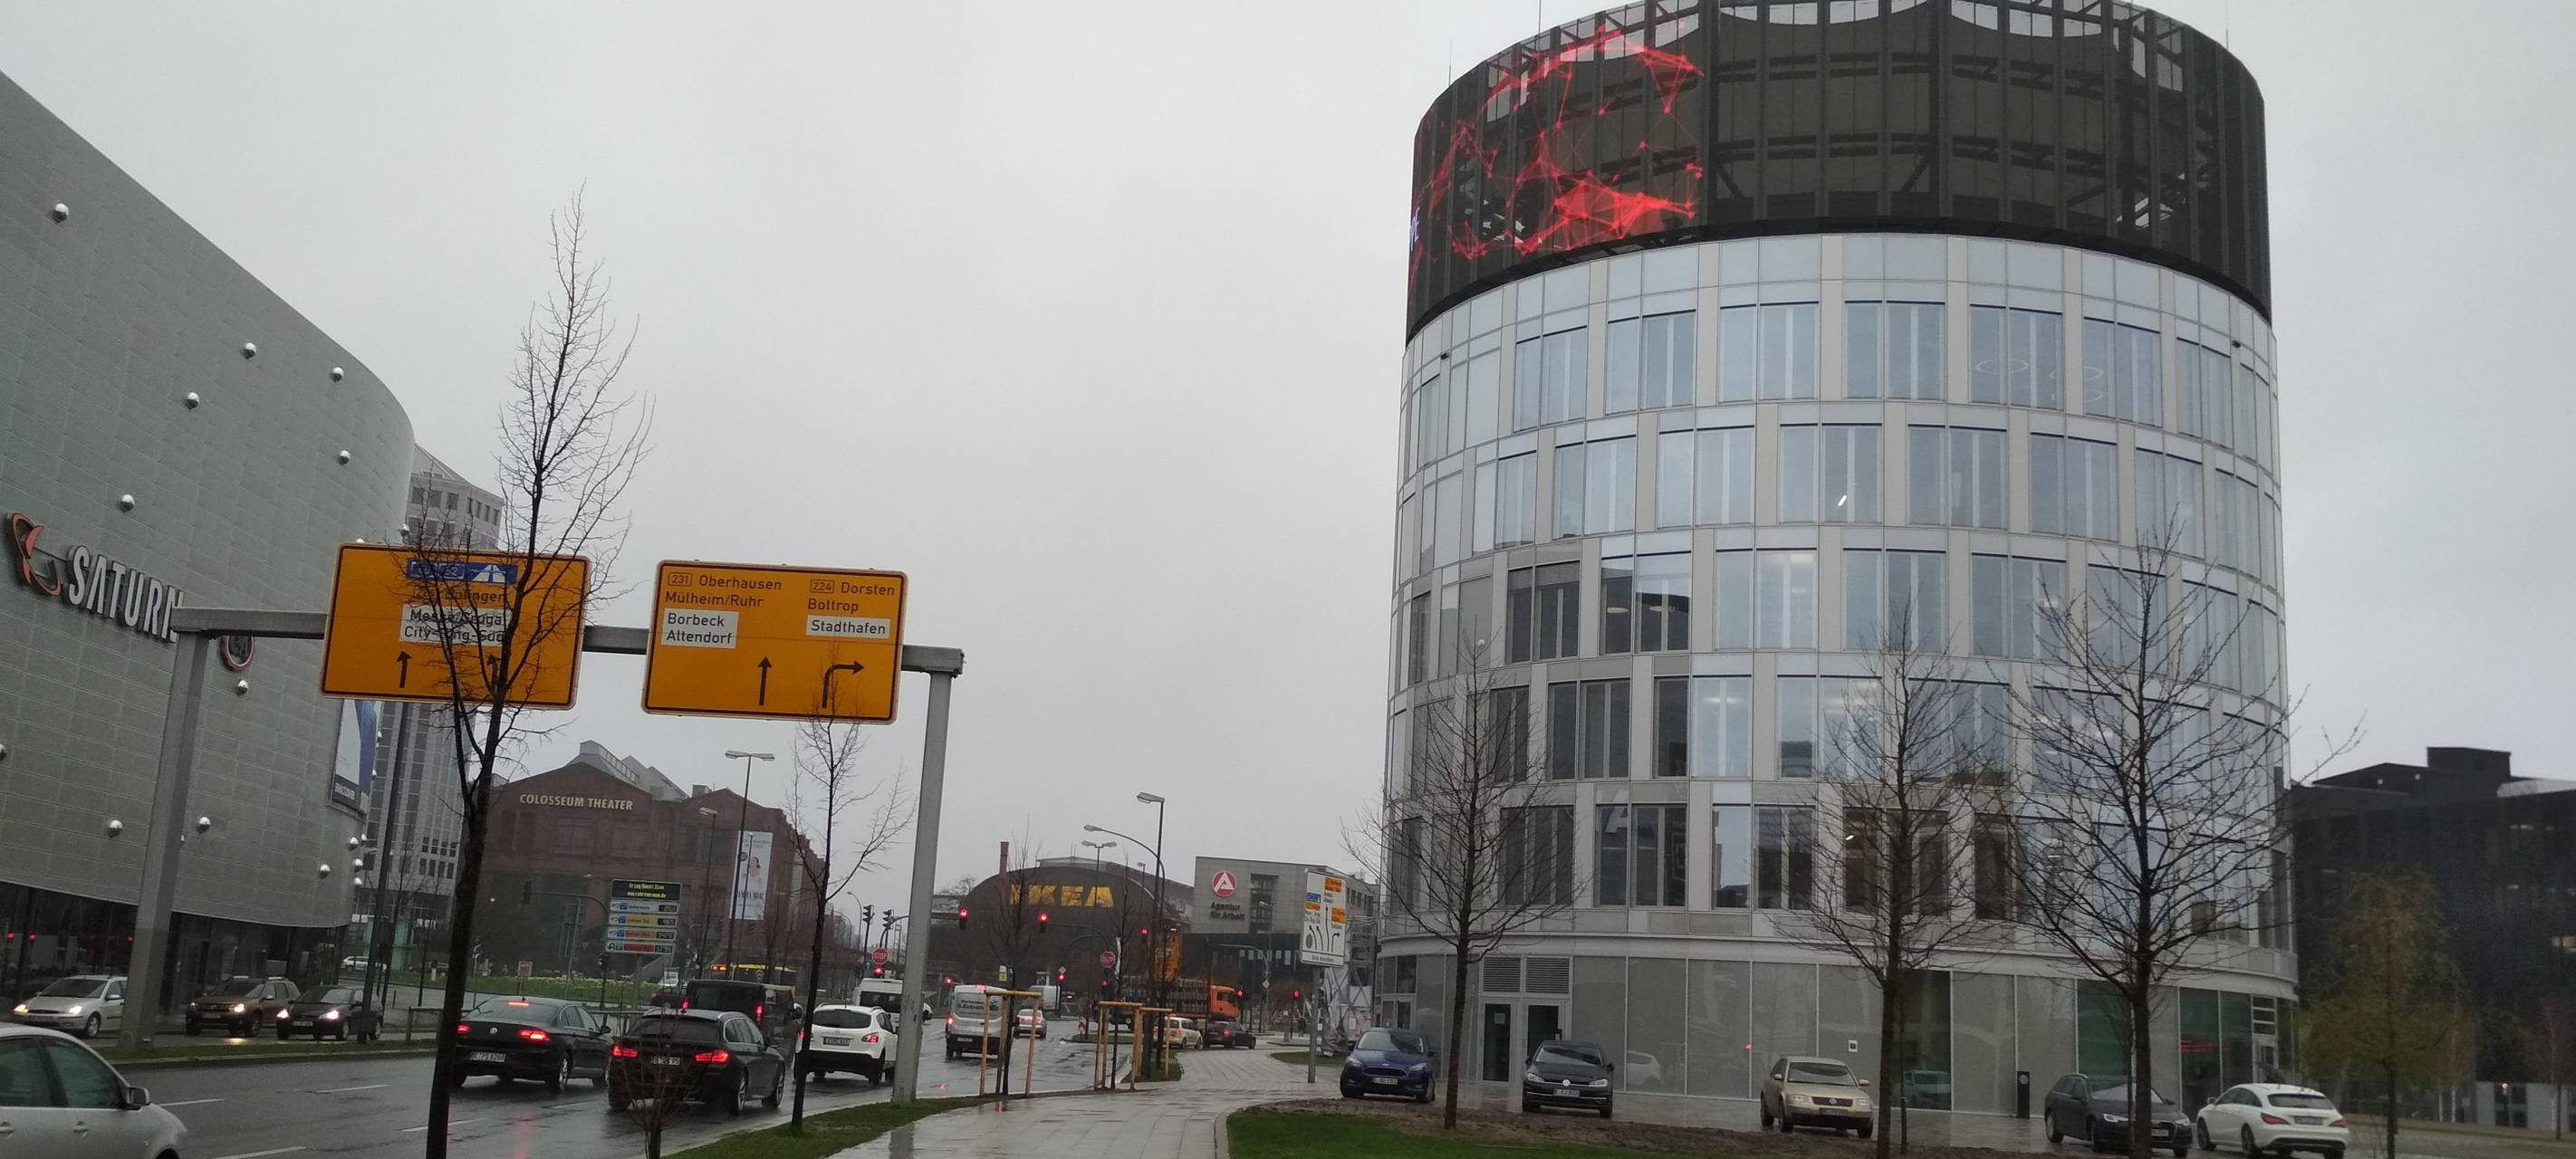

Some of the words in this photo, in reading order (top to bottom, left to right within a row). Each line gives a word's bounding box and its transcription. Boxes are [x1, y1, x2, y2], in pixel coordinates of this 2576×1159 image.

[671, 575, 689, 584] 231
[698, 575, 783, 590] Oberhausen
[812, 581, 831, 591] 224
[841, 581, 895, 596] Dorsten
[68, 545, 184, 642] SATURN
[665, 591, 764, 608] Mülheim/Ruhr
[808, 598, 860, 614] Bottrop
[668, 612, 725, 627] Borbeck
[811, 619, 886, 635] Stadthafen
[666, 629, 733, 644] Altendorf
[520, 793, 584, 808] COLOSSEUM
[587, 798, 633, 810] THEATER
[1009, 884, 1114, 907] IKEA
